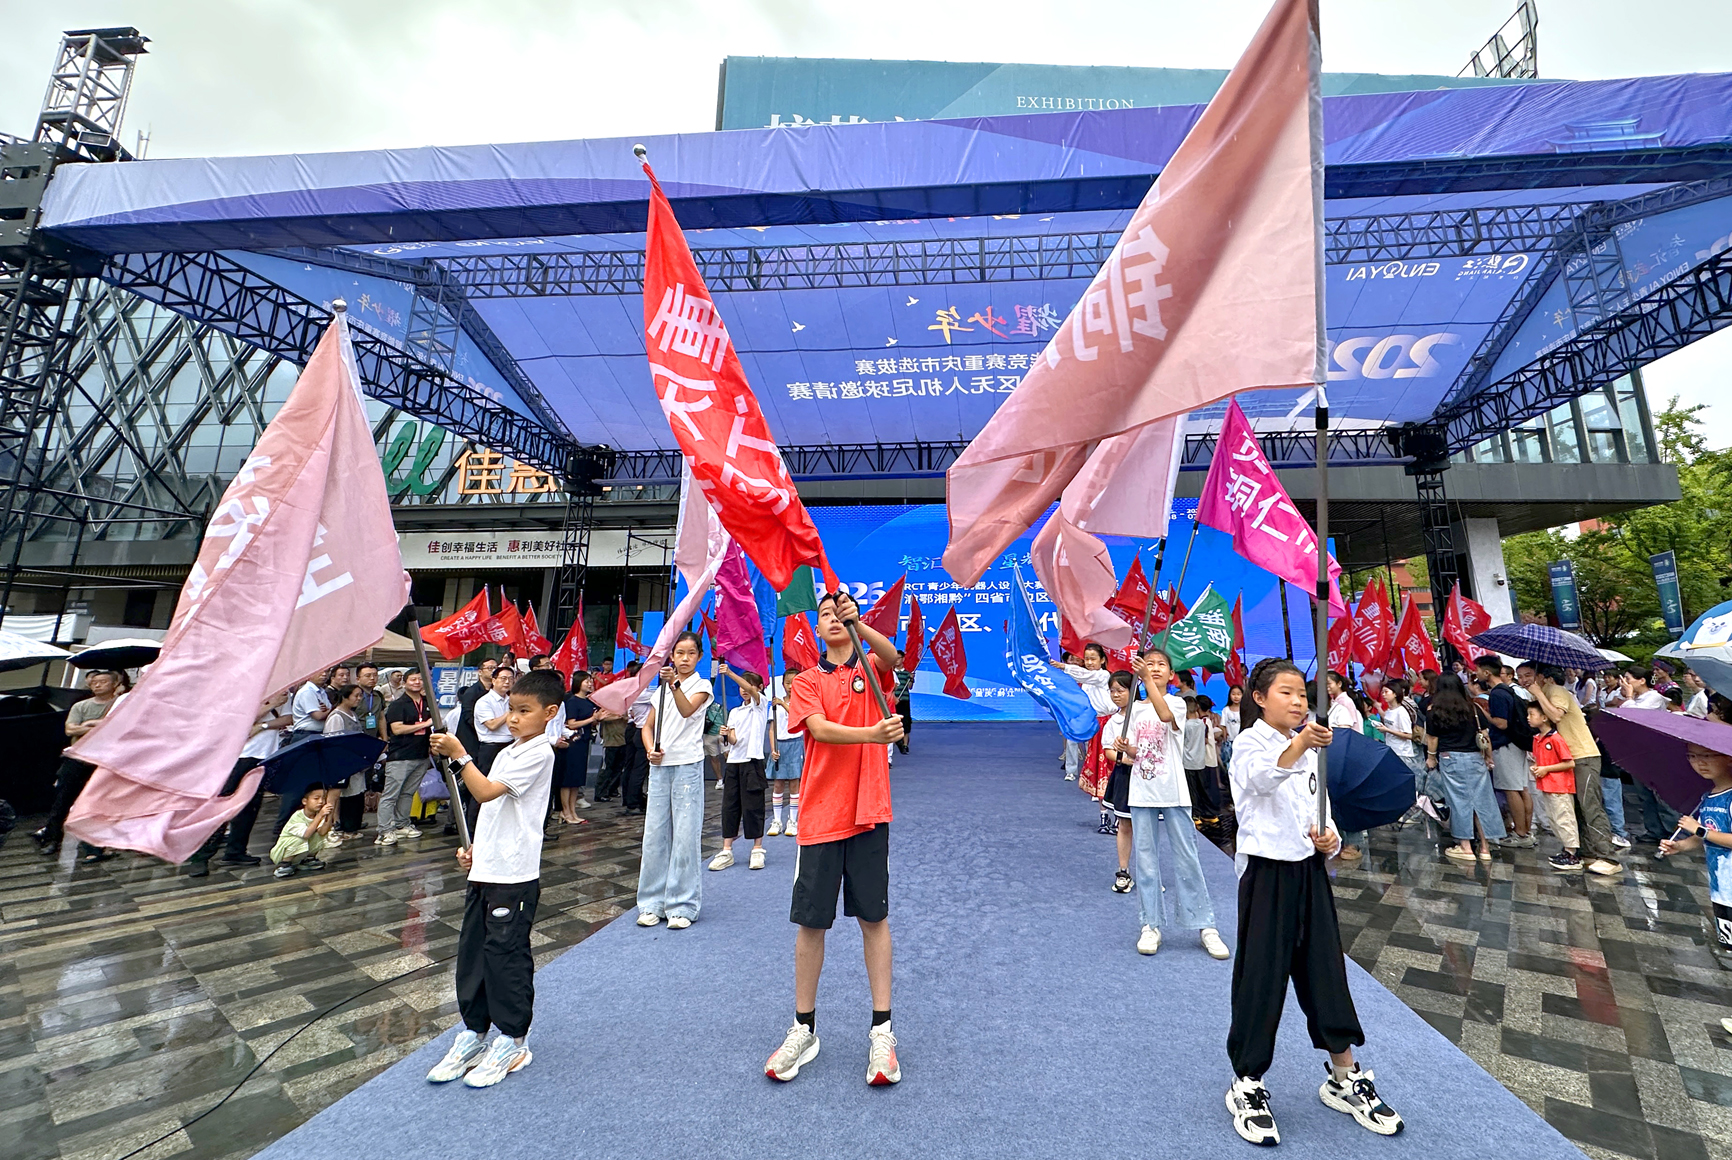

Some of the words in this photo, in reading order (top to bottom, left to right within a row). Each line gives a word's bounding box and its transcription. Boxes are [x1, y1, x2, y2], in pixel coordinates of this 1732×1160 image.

[1016, 95, 1135, 110] EXHIBITION
[427, 540, 498, 554] 佳创幸福生活
[898, 554, 943, 572] 智汇
[815, 581, 885, 606] 226
[927, 581, 1044, 592] 青少年器人设大赛
